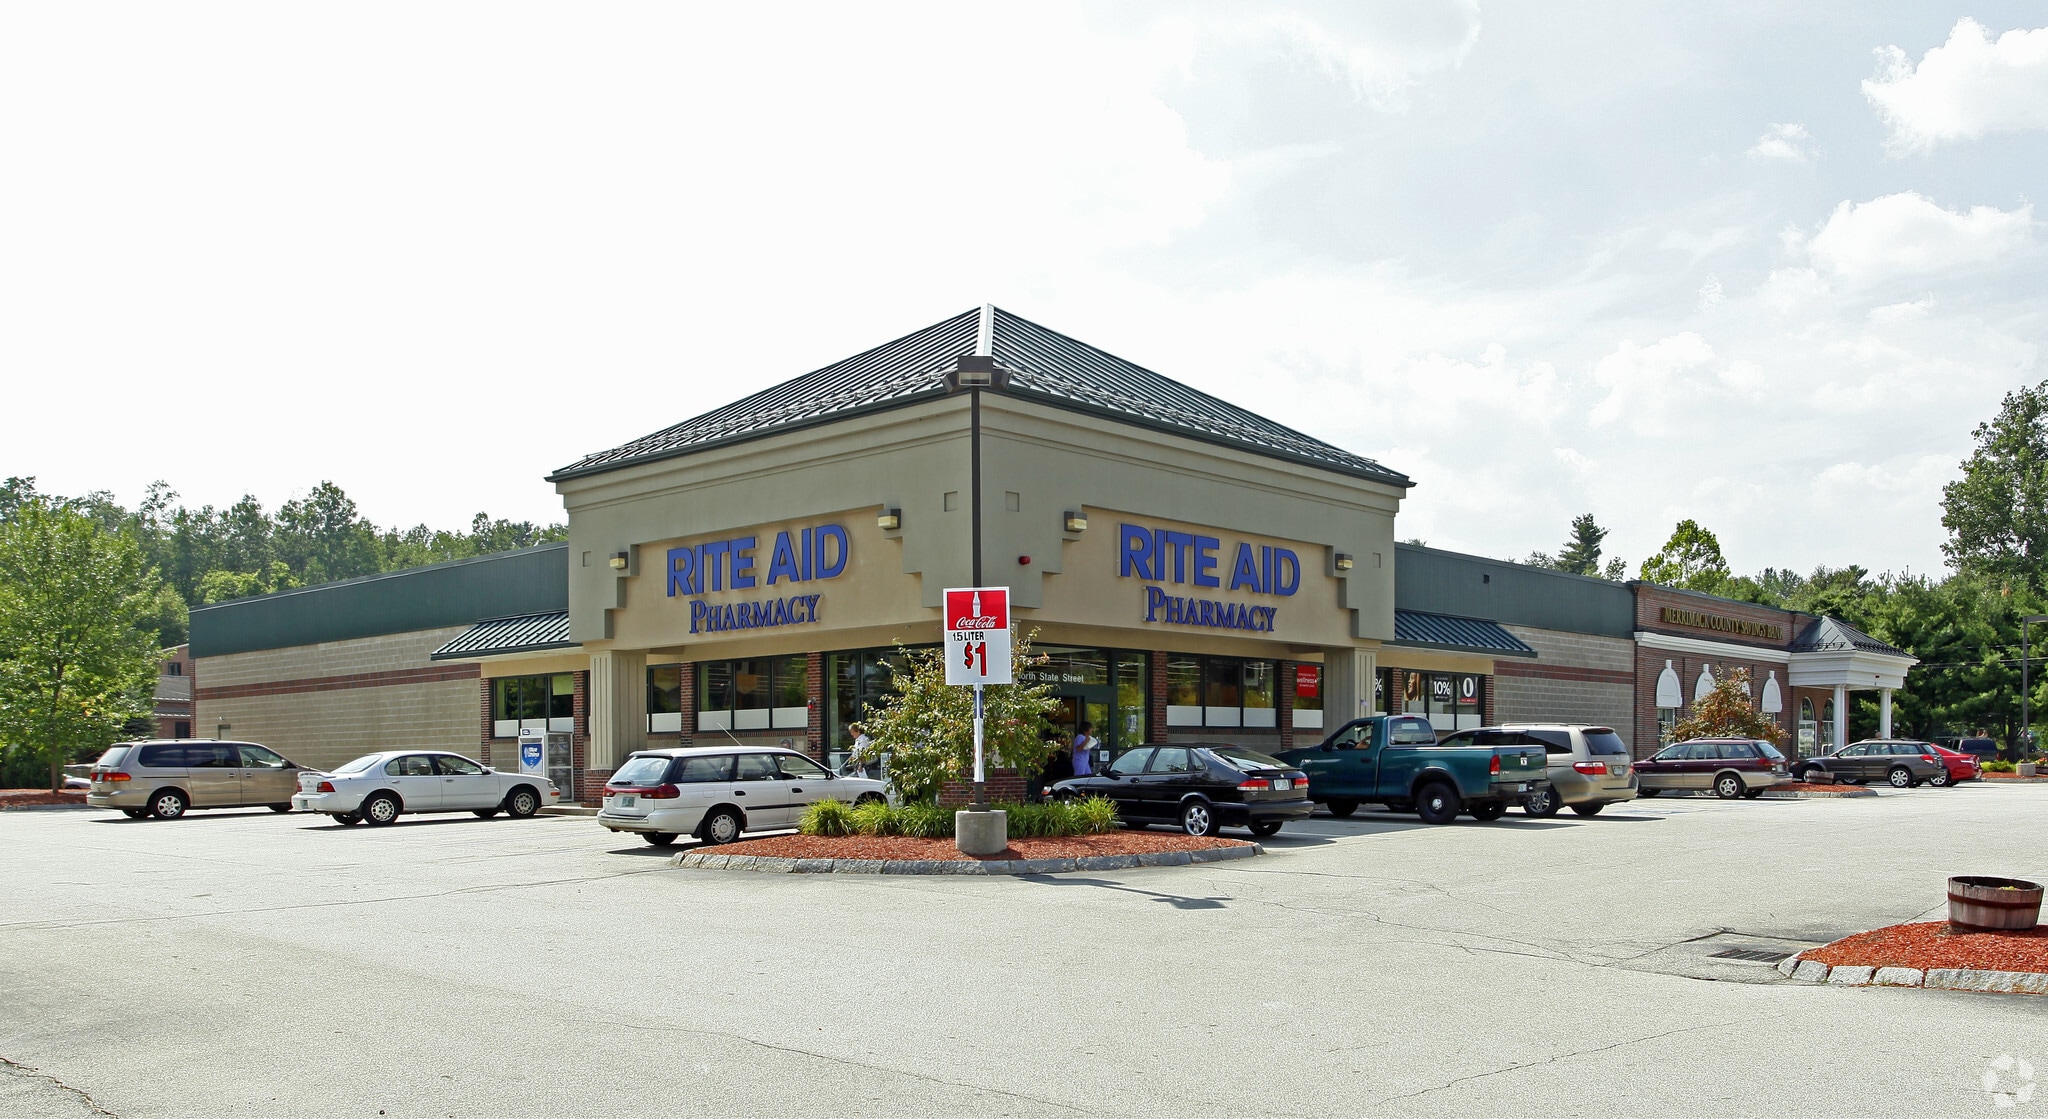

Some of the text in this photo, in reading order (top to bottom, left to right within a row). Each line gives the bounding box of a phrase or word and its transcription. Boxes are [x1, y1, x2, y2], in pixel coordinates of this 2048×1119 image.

[667, 524, 848, 597] RITE AID
[1119, 523, 1301, 596] RITE AID
[689, 595, 820, 634] PHARMACY
[956, 615, 998, 629] Coca-Cola
[1144, 586, 1277, 632] PHARMACY
[1664, 607, 1783, 640] MERRIMACK COUNTY SAVINGS BANK
[964, 631, 985, 641] LITER
[963, 641, 987, 677] $1
[1039, 671, 1059, 682] State
[1062, 673, 1085, 683] Street
[1433, 680, 1450, 695] 10%
